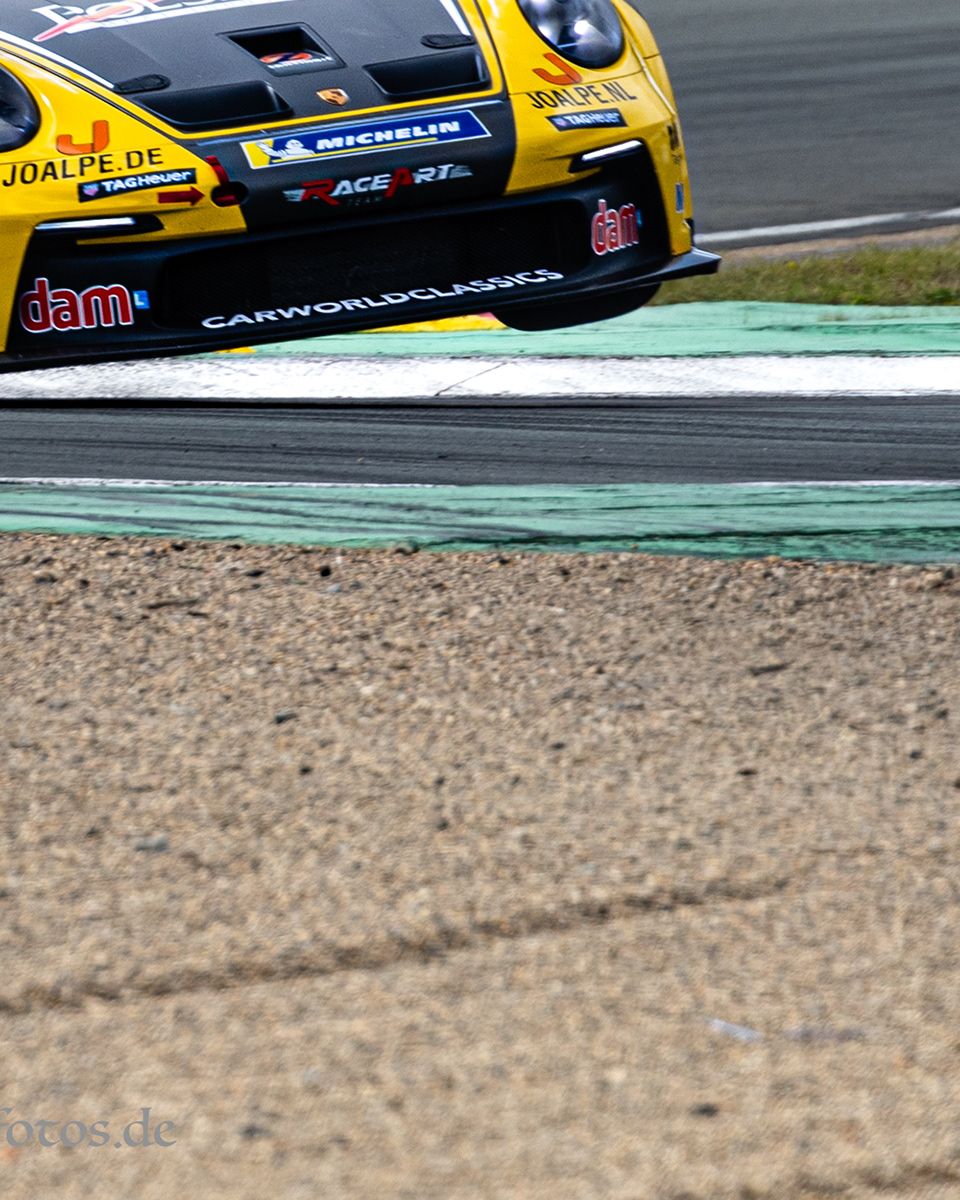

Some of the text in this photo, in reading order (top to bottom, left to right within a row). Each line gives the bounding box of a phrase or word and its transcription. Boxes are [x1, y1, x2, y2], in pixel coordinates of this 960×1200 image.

[526, 81, 638, 109] JOALPE.NL
[316, 120, 461, 150] MICHELIN
[3, 147, 164, 187] JOALPE.DE
[591, 198, 640, 256] dam
[18, 277, 135, 334] dam
[201, 268, 565, 329] CARWORLDCLASSICS
